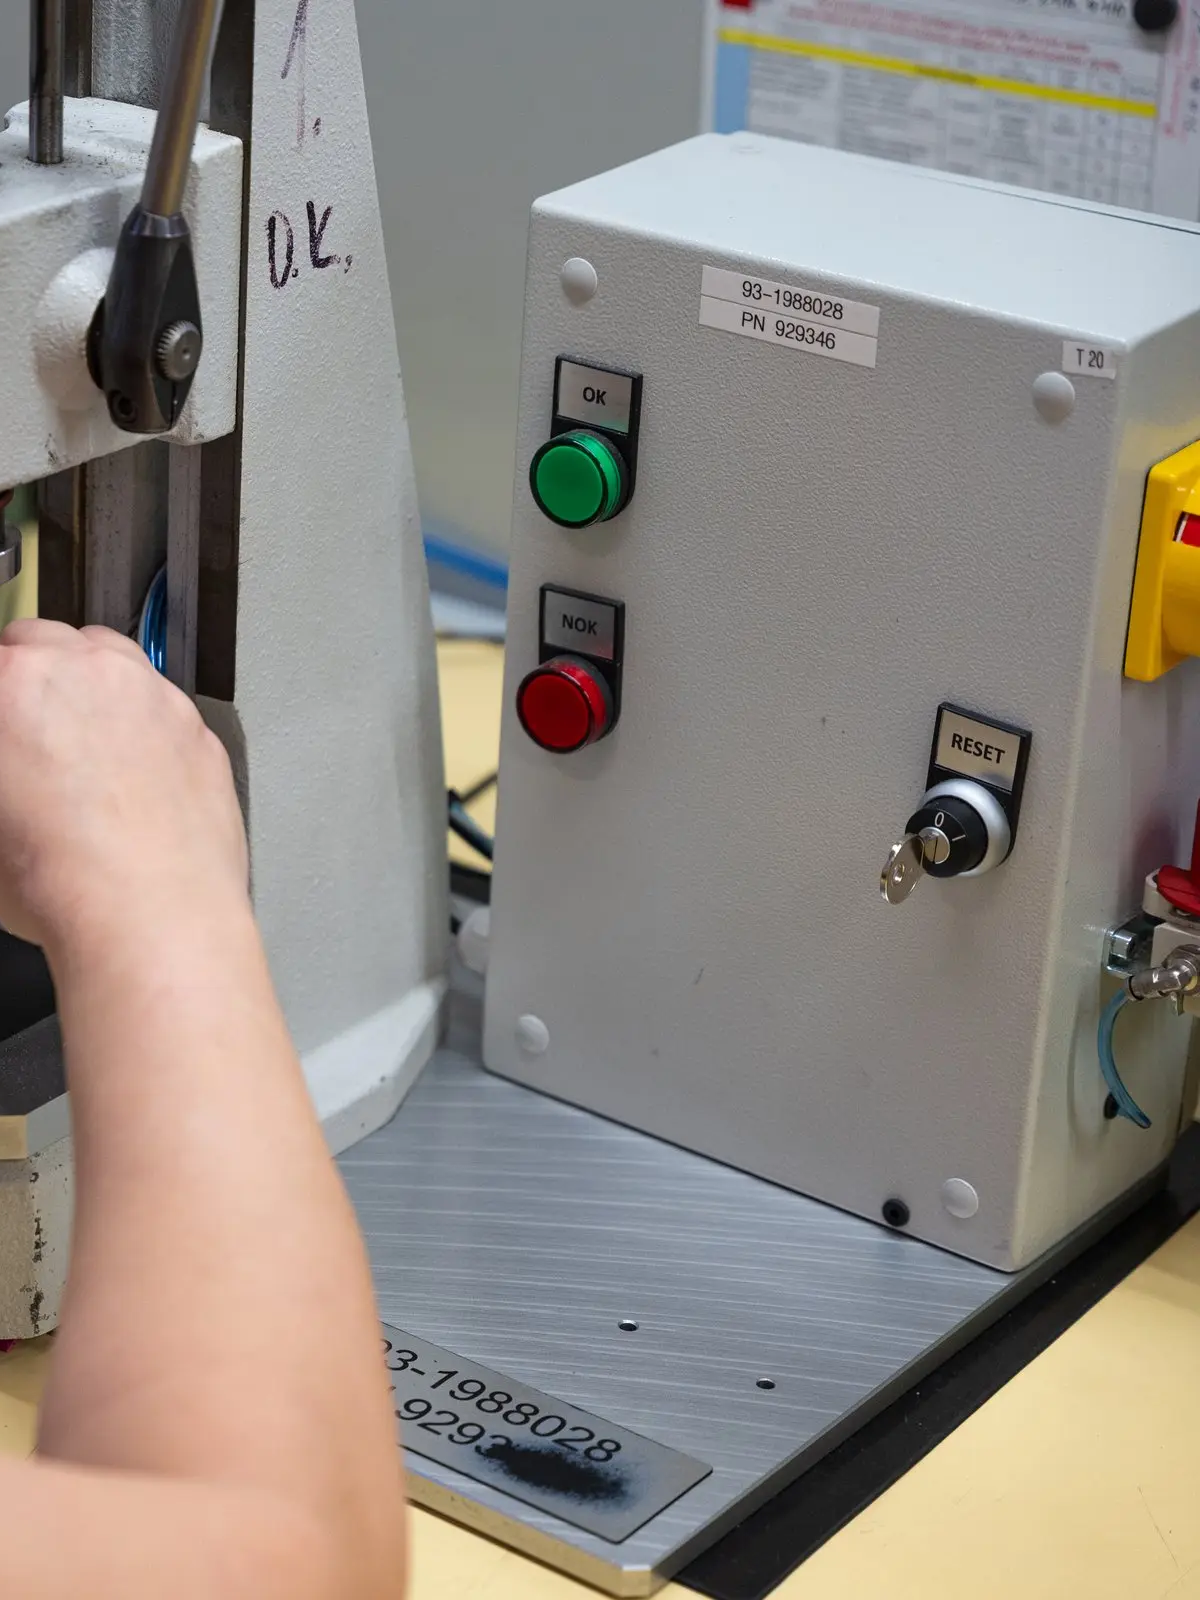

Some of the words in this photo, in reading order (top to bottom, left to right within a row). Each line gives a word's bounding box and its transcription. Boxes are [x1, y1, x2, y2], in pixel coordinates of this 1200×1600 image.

[741, 280, 844, 321] 93-1988028
[741, 311, 766, 333] PN
[775, 320, 837, 350] 929346
[1076, 348, 1085, 367] T
[1088, 350, 1104, 369] 20
[582, 386, 607, 406] OK
[561, 613, 598, 636] NOK
[951, 732, 1006, 764] RESET
